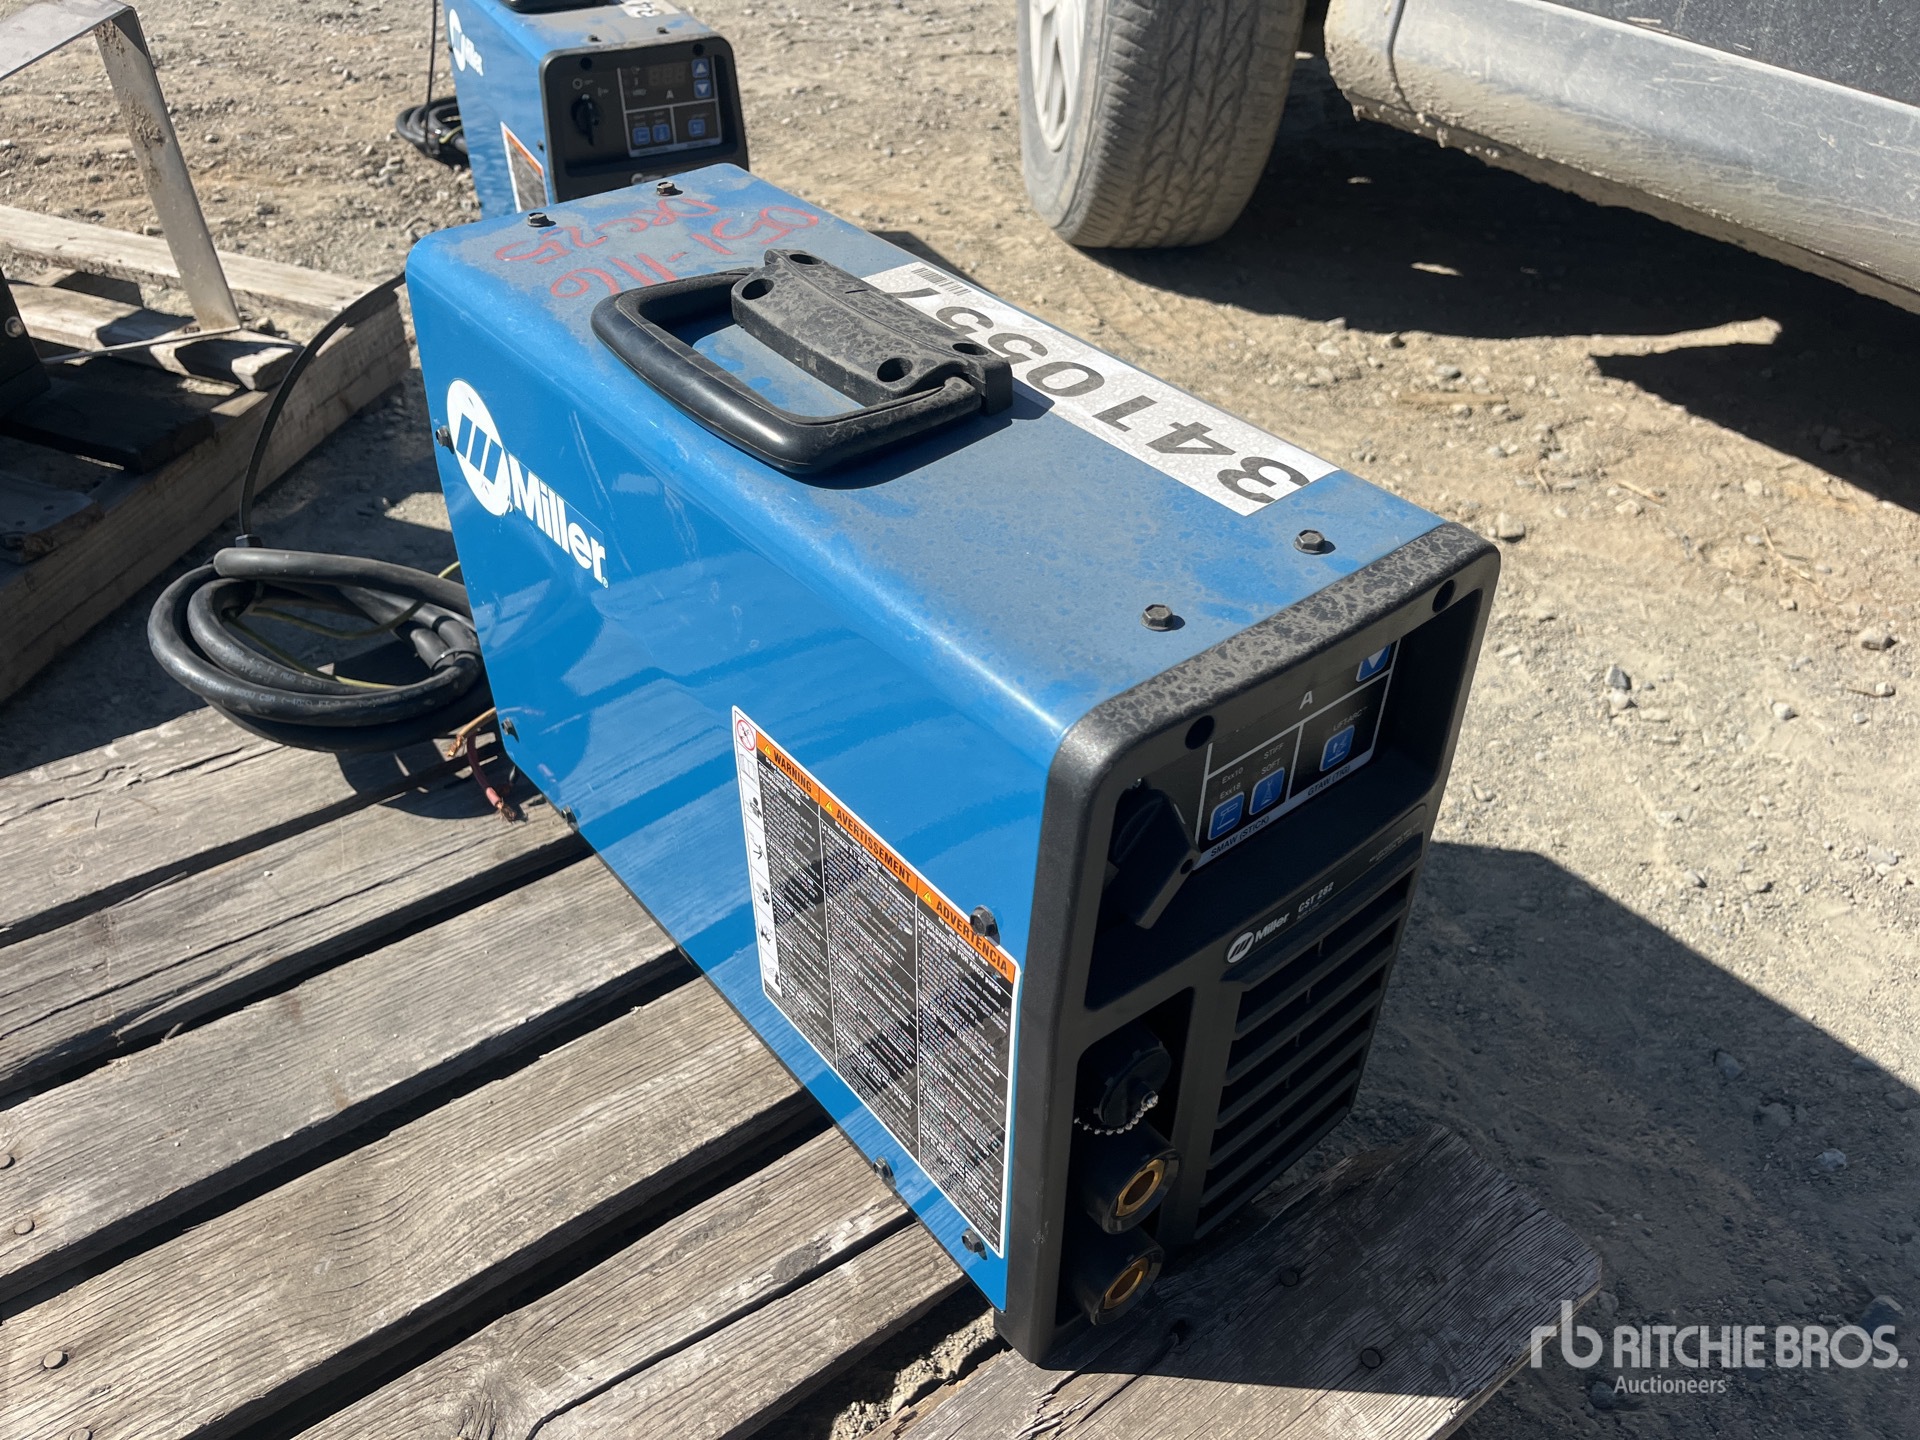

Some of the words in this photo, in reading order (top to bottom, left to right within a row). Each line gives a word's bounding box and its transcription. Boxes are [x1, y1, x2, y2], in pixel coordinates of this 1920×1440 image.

[508, 453, 605, 583] Miller
[1300, 691, 1313, 710] A
[1261, 758, 1281, 775] SOFT
[1264, 743, 1284, 760] STIFF
[774, 750, 812, 793] WARNING
[1222, 767, 1244, 784] Exx10
[1308, 774, 1332, 796] GTAW
[837, 809, 911, 882] AVERTISSEMENT
[1210, 832, 1239, 857] SMAW
[1239, 815, 1270, 846] (STICK)
[937, 901, 1007, 974] ADVERTENCIA
[1255, 913, 1290, 943] Miller
